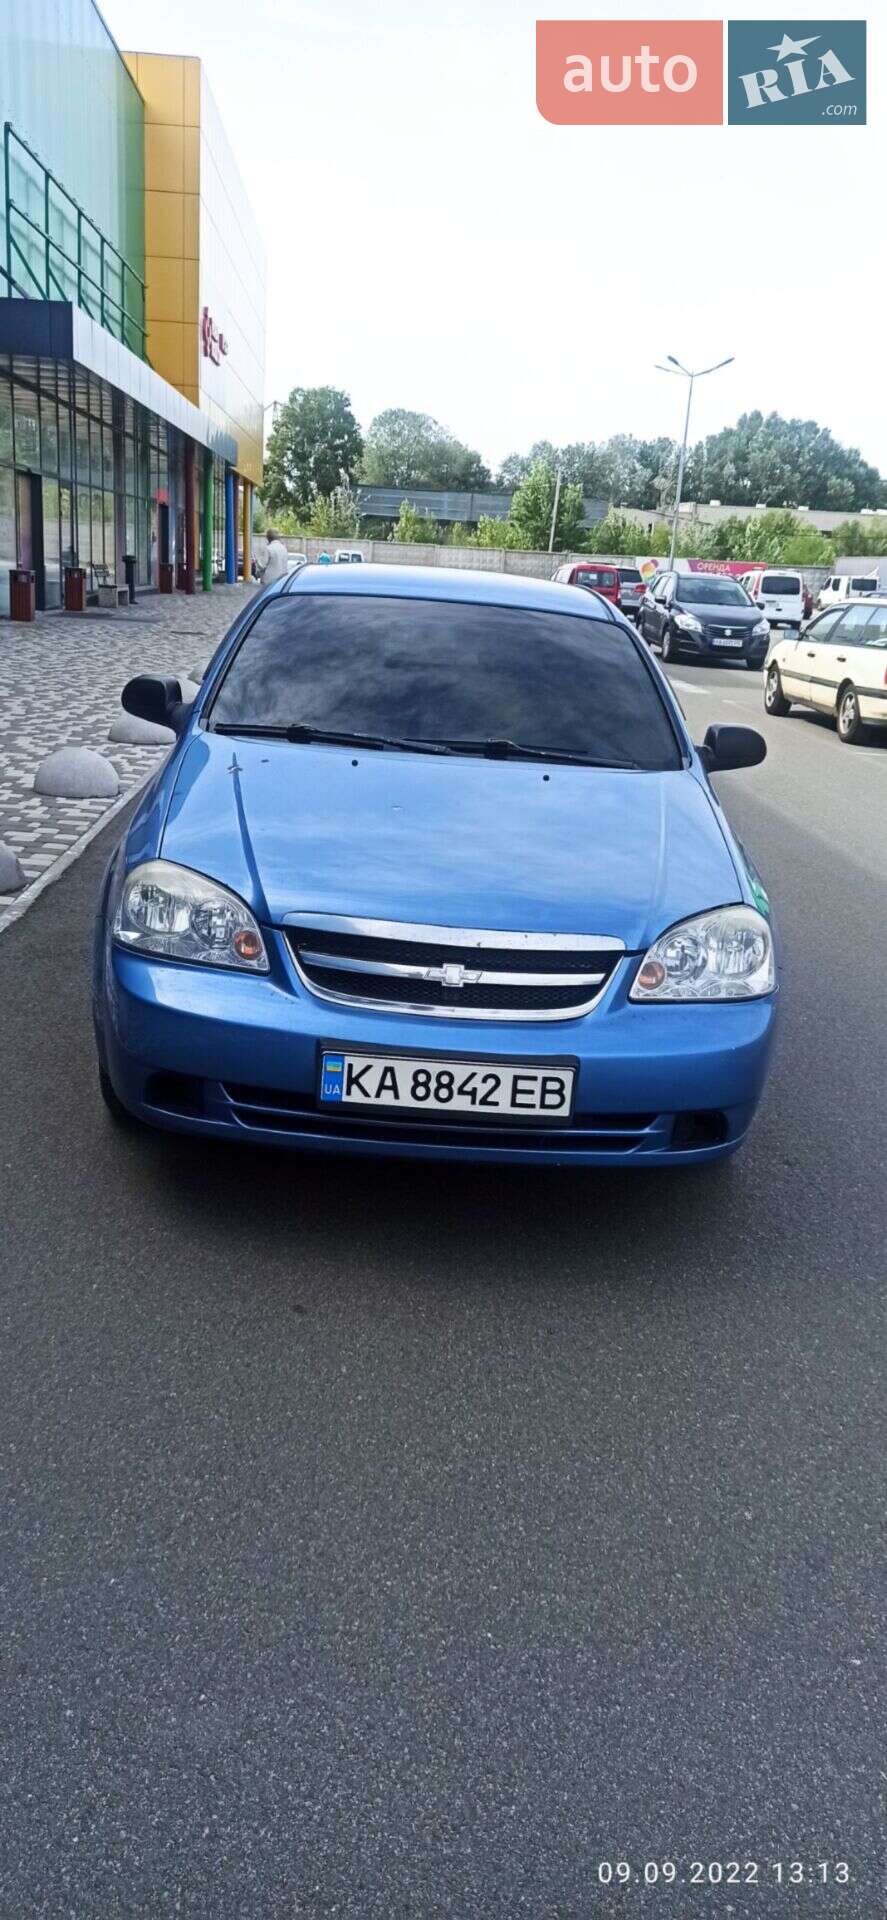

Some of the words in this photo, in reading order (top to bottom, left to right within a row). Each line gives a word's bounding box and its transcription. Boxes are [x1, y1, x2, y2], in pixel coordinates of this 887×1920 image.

[697, 561, 731, 572] ОРЕНДА
[324, 1084, 341, 1095] UA
[345, 1063, 401, 1100] KA
[410, 1068, 501, 1107] 8842
[510, 1074, 566, 1110] EB
